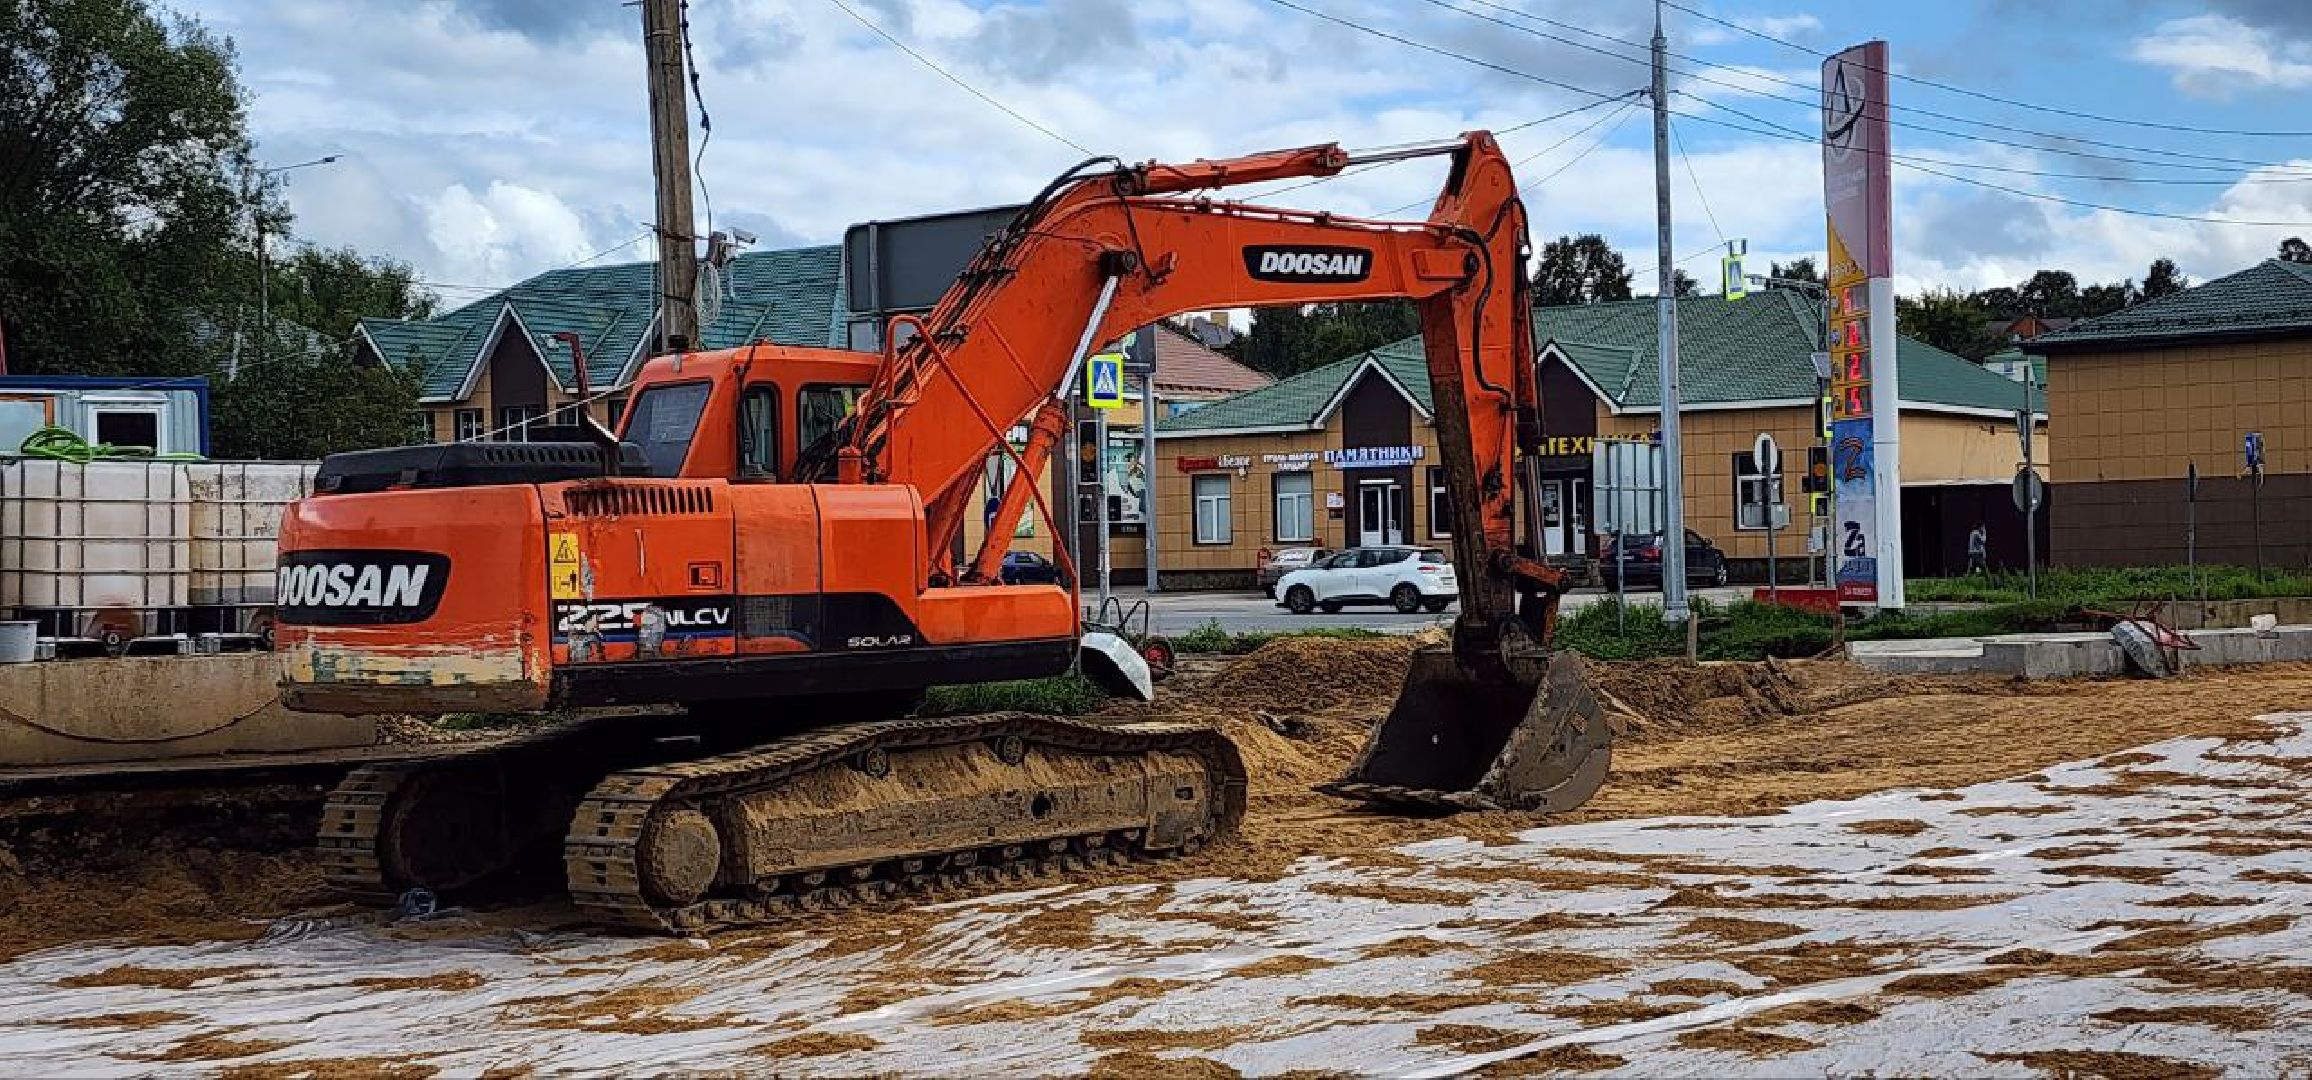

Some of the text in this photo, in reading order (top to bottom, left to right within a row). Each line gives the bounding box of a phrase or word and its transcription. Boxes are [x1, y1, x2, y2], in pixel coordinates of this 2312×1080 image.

[1260, 252, 1363, 275] DOOSAN
[1324, 445, 1424, 463] ПАМЯТНИКИ
[278, 563, 429, 606] DOOSAN
[847, 635, 912, 648] SOLAR
